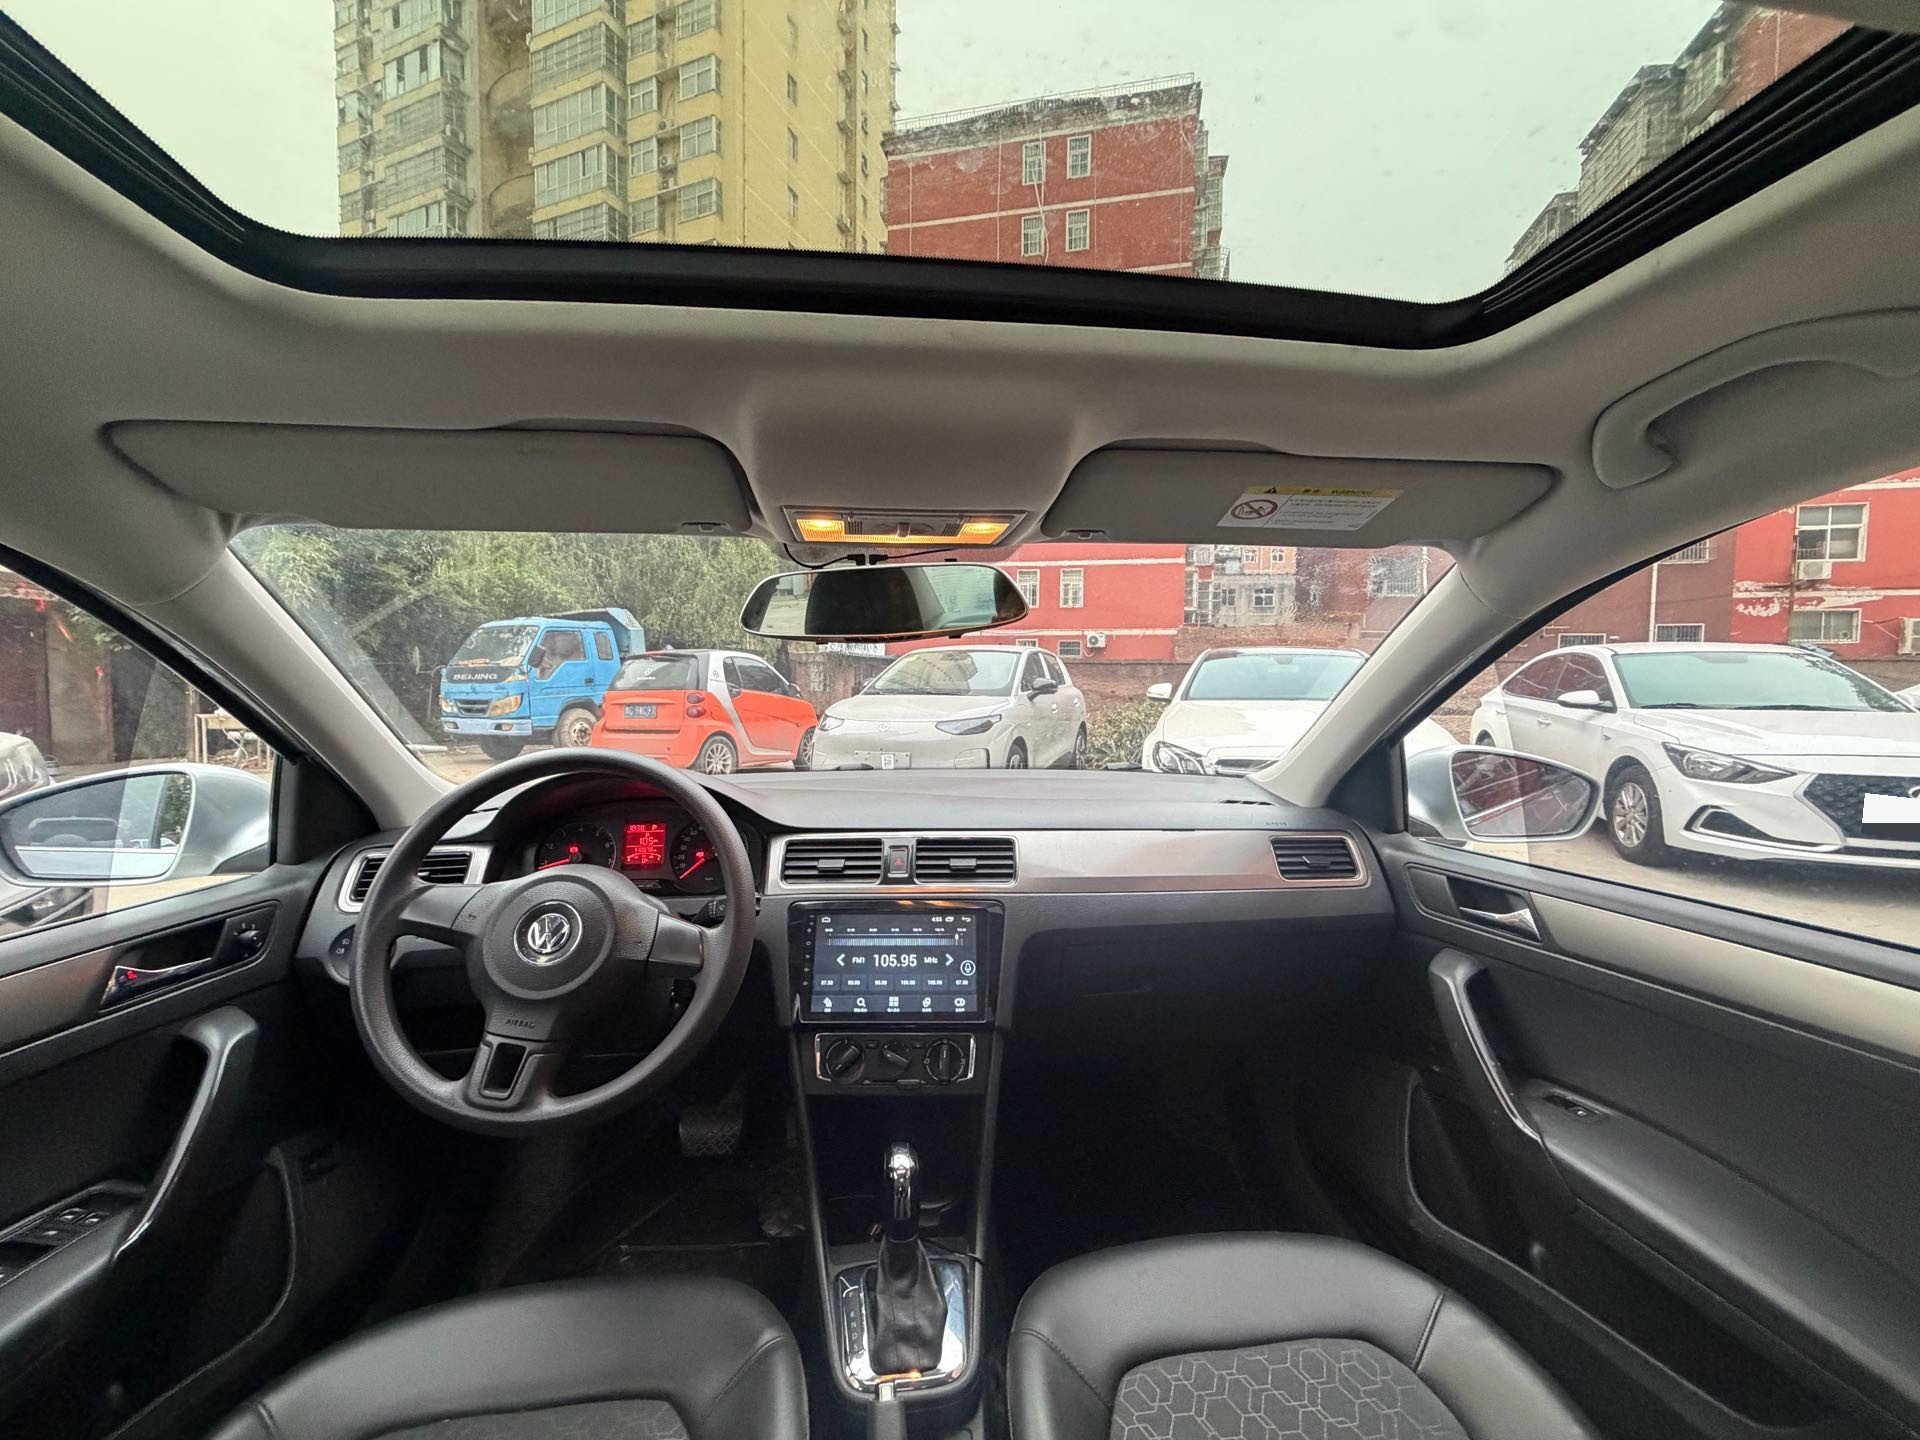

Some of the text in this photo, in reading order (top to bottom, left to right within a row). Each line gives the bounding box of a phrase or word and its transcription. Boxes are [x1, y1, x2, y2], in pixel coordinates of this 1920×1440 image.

[453, 673, 498, 681] BEIJING
[873, 954, 917, 968] 105.95
[924, 956, 938, 964] MHz
[505, 1017, 536, 1029] AIRBAG
